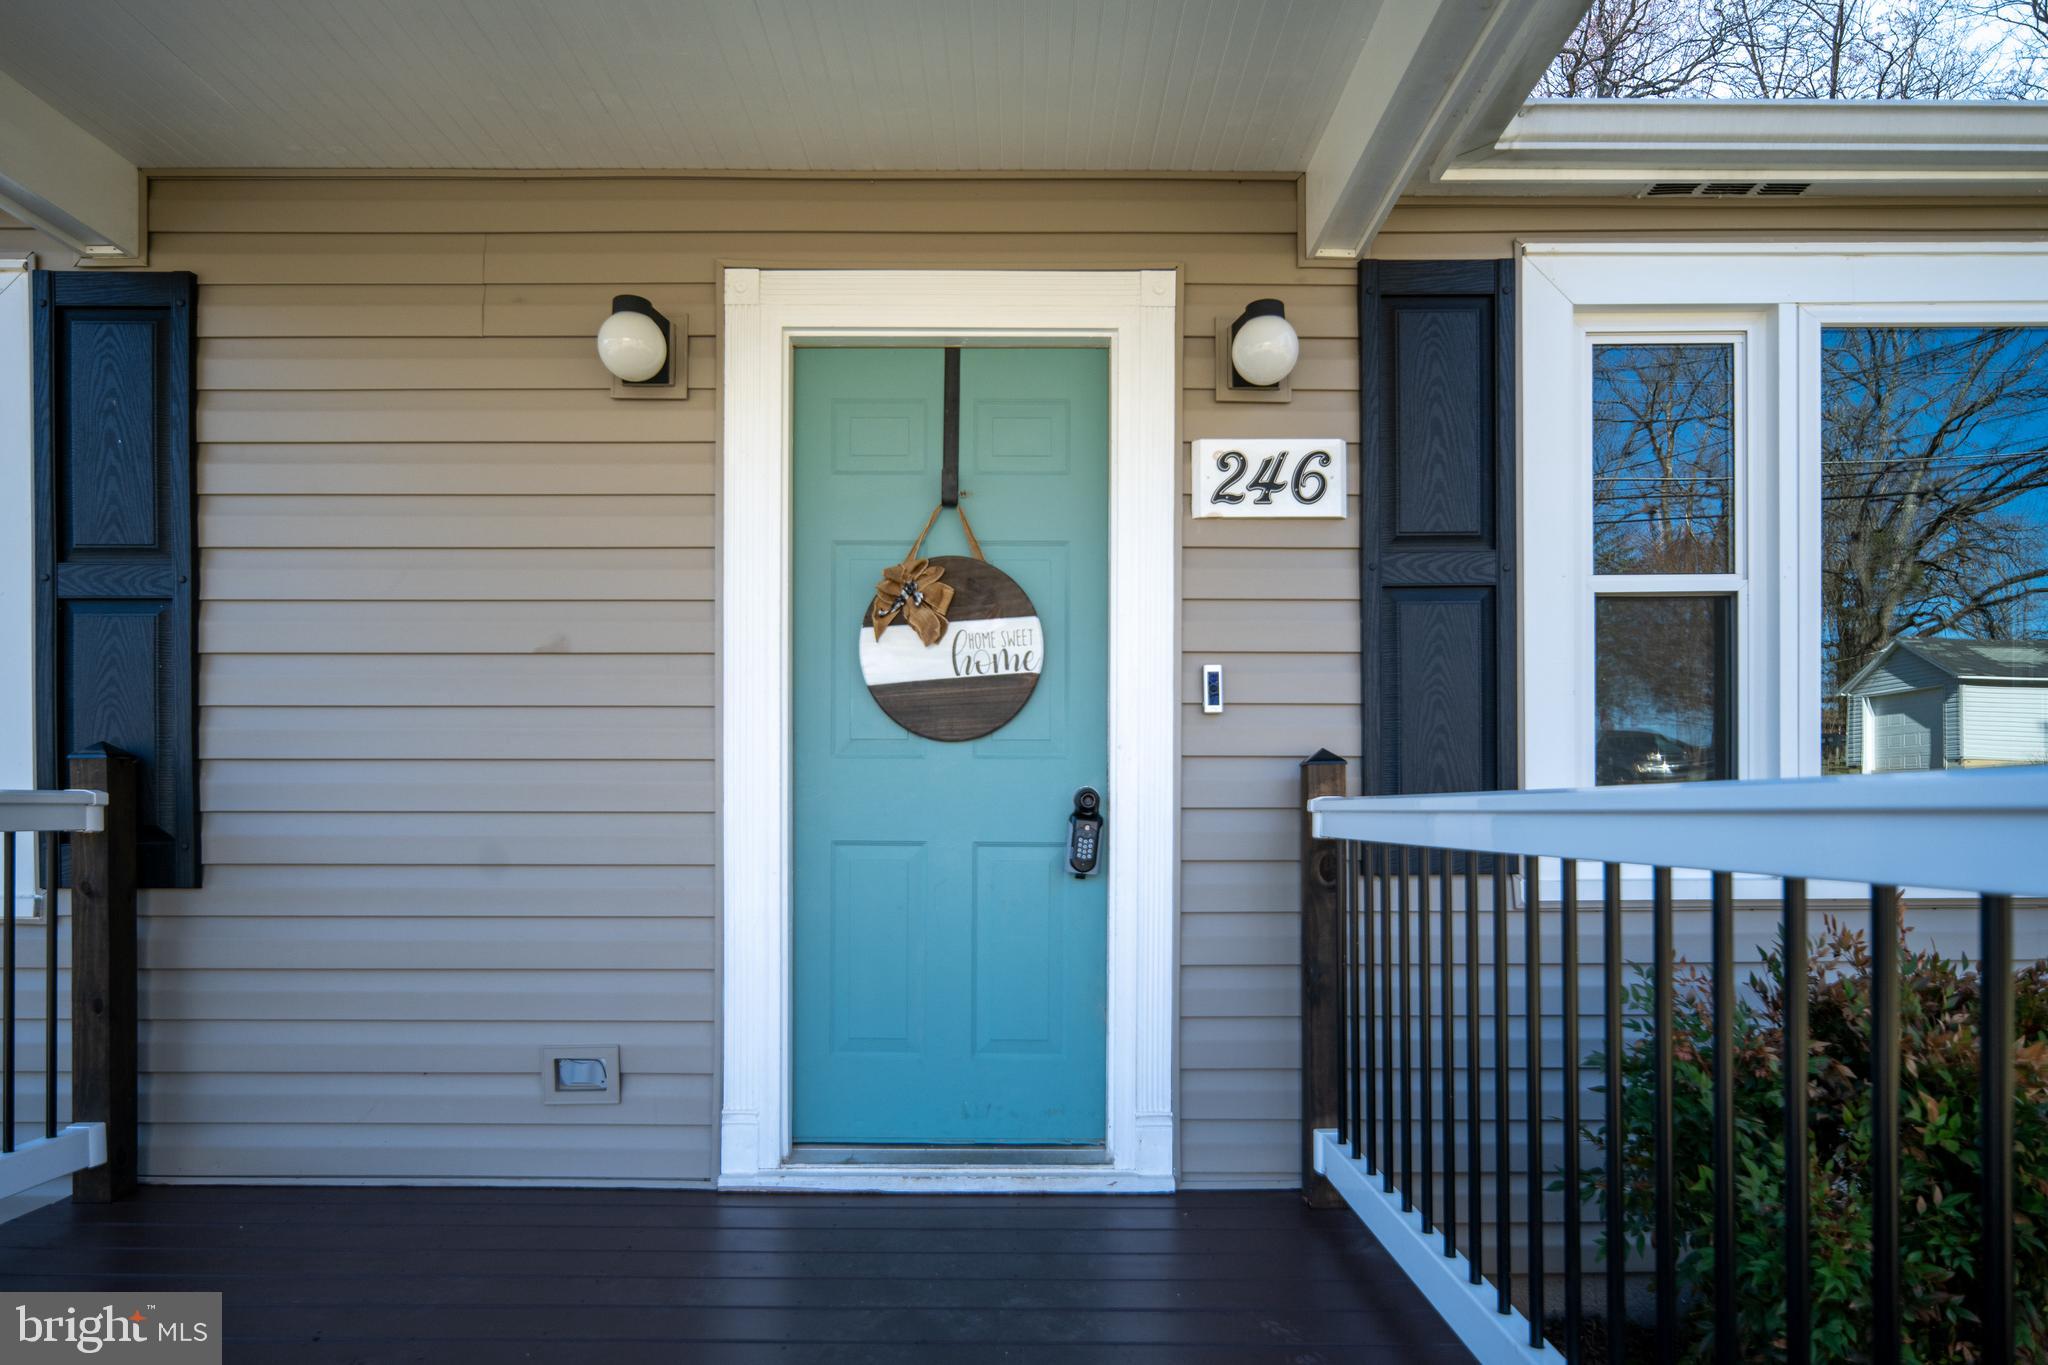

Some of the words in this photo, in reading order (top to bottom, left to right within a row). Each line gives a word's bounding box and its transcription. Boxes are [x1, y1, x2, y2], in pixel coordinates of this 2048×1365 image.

[1210, 450, 1332, 505] 246
[952, 629, 1041, 676] home
[968, 631, 996, 649] HOME
[1002, 628, 1033, 648] SWEET
